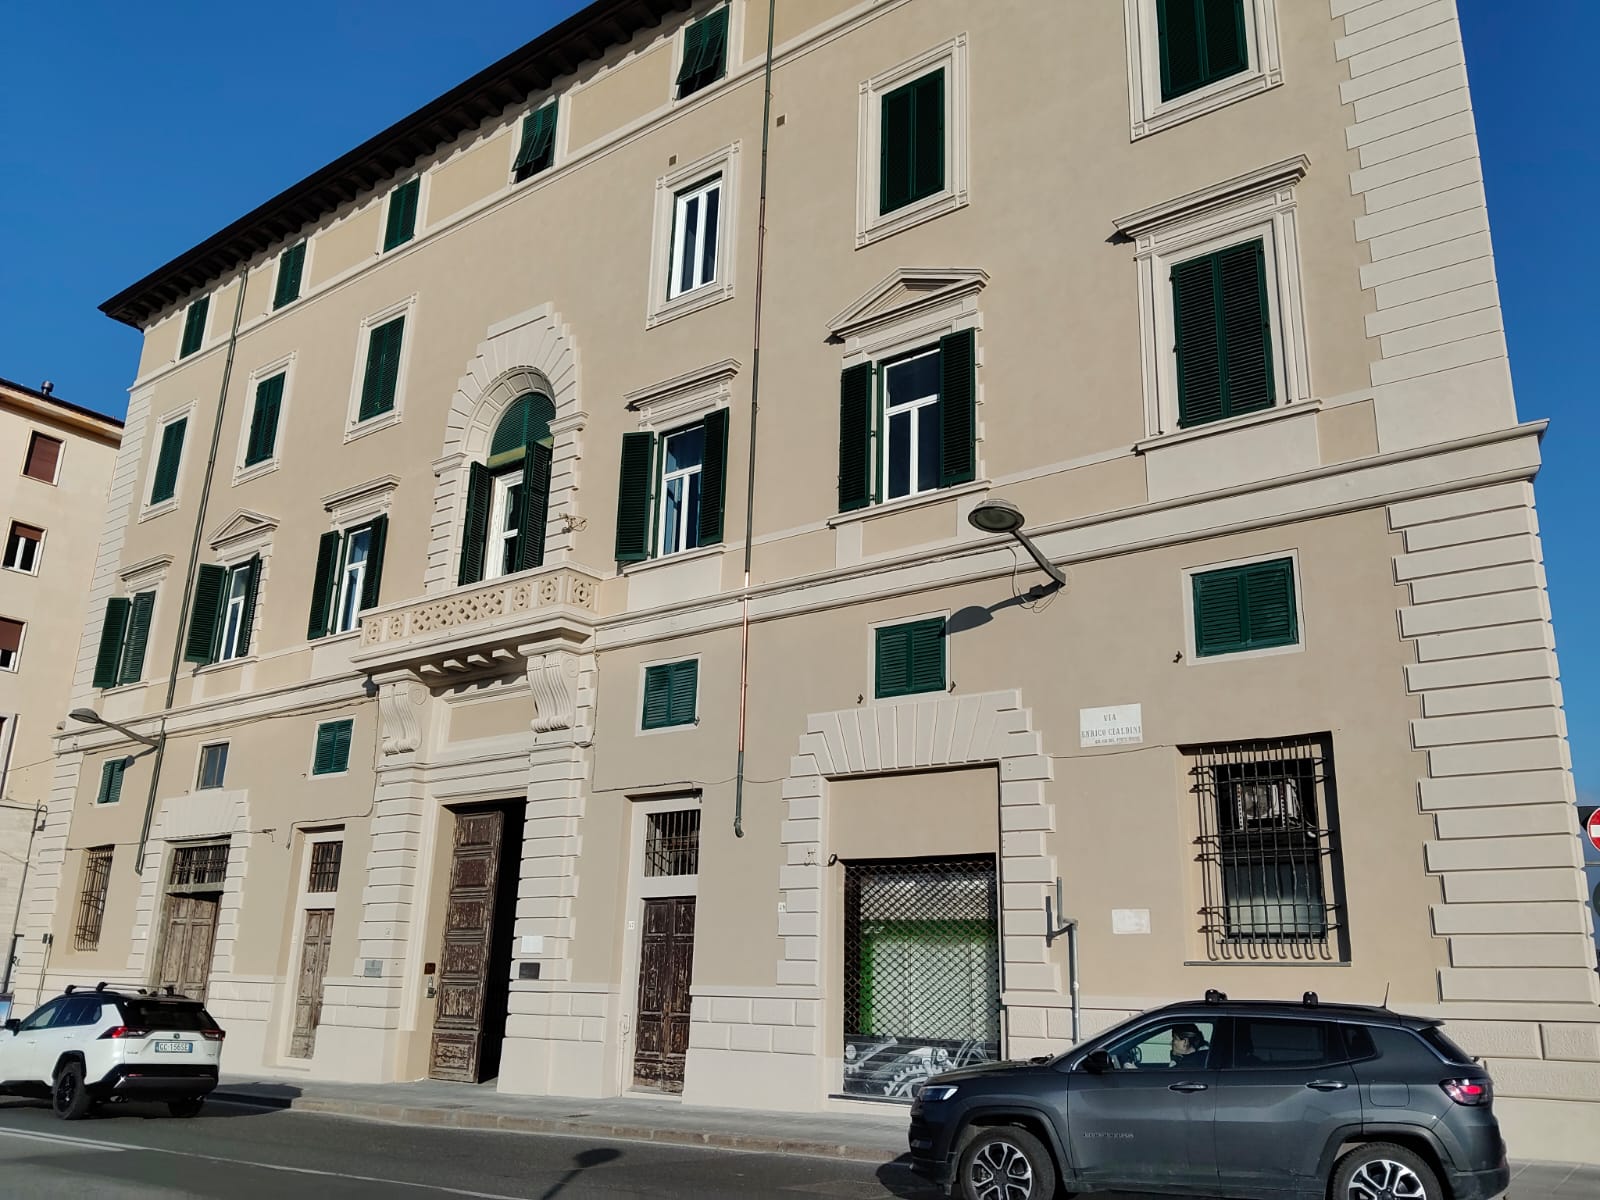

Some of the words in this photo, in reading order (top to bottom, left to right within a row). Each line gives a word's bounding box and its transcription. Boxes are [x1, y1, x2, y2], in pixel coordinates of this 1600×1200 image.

[1103, 713, 1117, 722] VIA
[1081, 729, 1107, 738] ENRICO
[1108, 725, 1141, 736] CIALDINI
